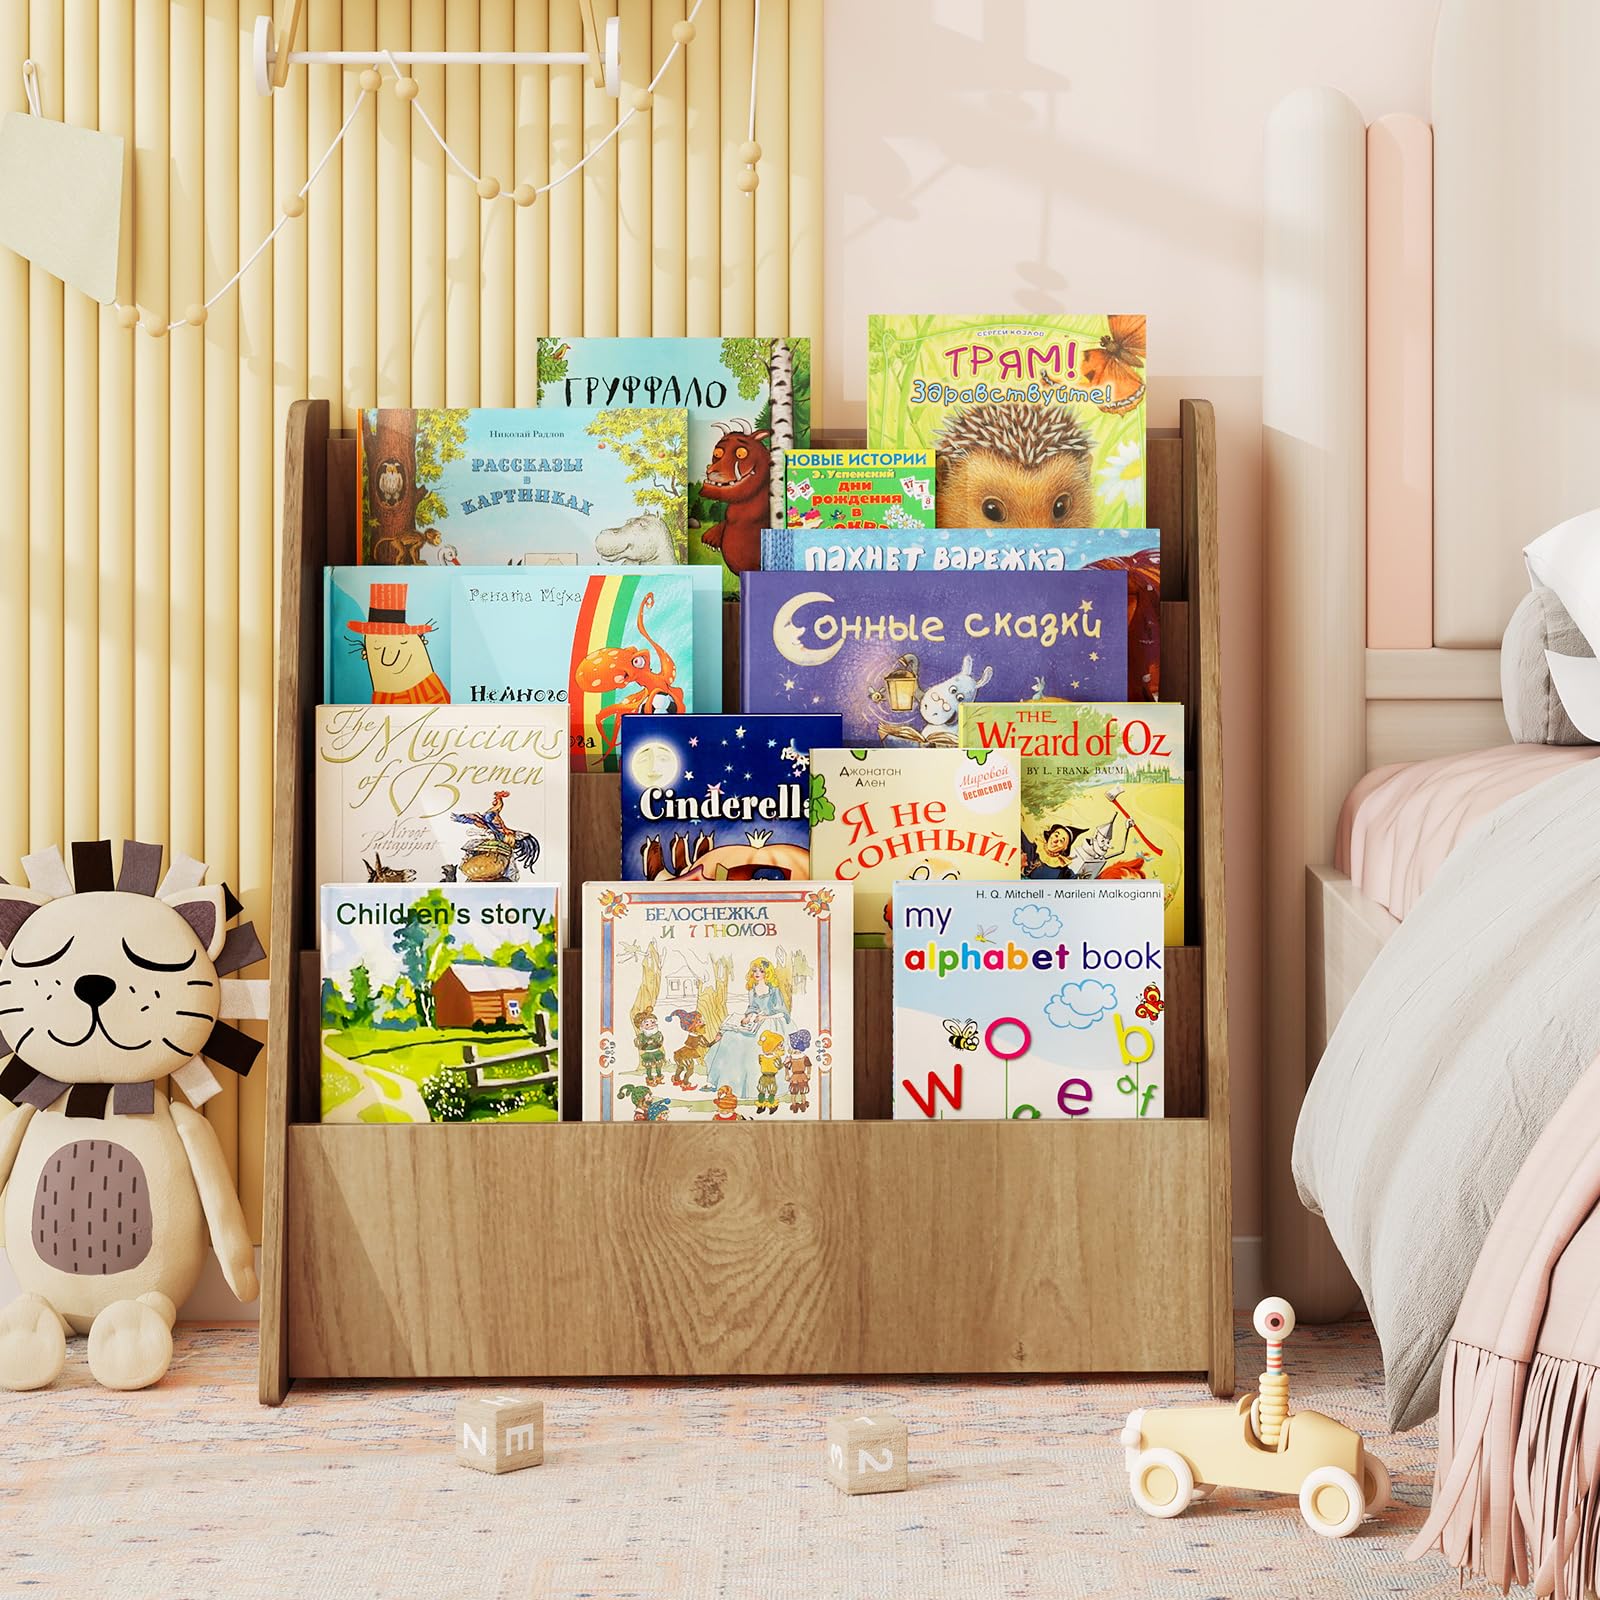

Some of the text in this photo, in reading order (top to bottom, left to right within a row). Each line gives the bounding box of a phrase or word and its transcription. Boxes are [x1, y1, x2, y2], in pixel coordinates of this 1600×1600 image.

[945, 342, 1076, 380] ТРЯМ!
[565, 375, 727, 408] ГРУФФАЛО
[911, 380, 1112, 407] Здравствуйте!
[489, 430, 565, 438] Николай Радлов
[471, 458, 583, 472] РАССКАЗЫ
[787, 453, 926, 466] НОВЫЕ ИСТОРИИ
[812, 469, 895, 479] Э. Успенский
[904, 480, 914, 489] 17
[800, 483, 810, 494] 30
[460, 488, 594, 516] КАРТИНКАХ
[469, 587, 581, 606] Рената Муха
[964, 609, 1101, 647] сказки
[1015, 711, 1057, 723] THE
[321, 706, 564, 763] The Musicians
[976, 719, 1172, 757] Wizard of Oz
[839, 766, 902, 778] Джонатан
[960, 766, 1009, 788] Мировой
[1026, 767, 1039, 775] BY
[1043, 767, 1052, 775] L.
[1056, 766, 1090, 775] FRANK
[350, 752, 544, 819] of Bremen
[855, 777, 886, 788] Ален
[841, 801, 946, 846] Я не
[835, 829, 1018, 881] сонный!
[976, 890, 987, 899] H.
[990, 890, 1002, 899] Q.
[1004, 890, 1044, 899] Mitchell
[1054, 890, 1096, 899] Marileni
[1098, 890, 1161, 901] Malkogianni
[336, 902, 546, 929] Children's story
[645, 907, 769, 921] БЕЛОСНЕЖКА
[905, 906, 951, 934] my
[689, 925, 697, 938] 7
[704, 923, 778, 938] ГНОМОВ
[904, 941, 1162, 978] alphabet book
[858, 1447, 893, 1474] 2
